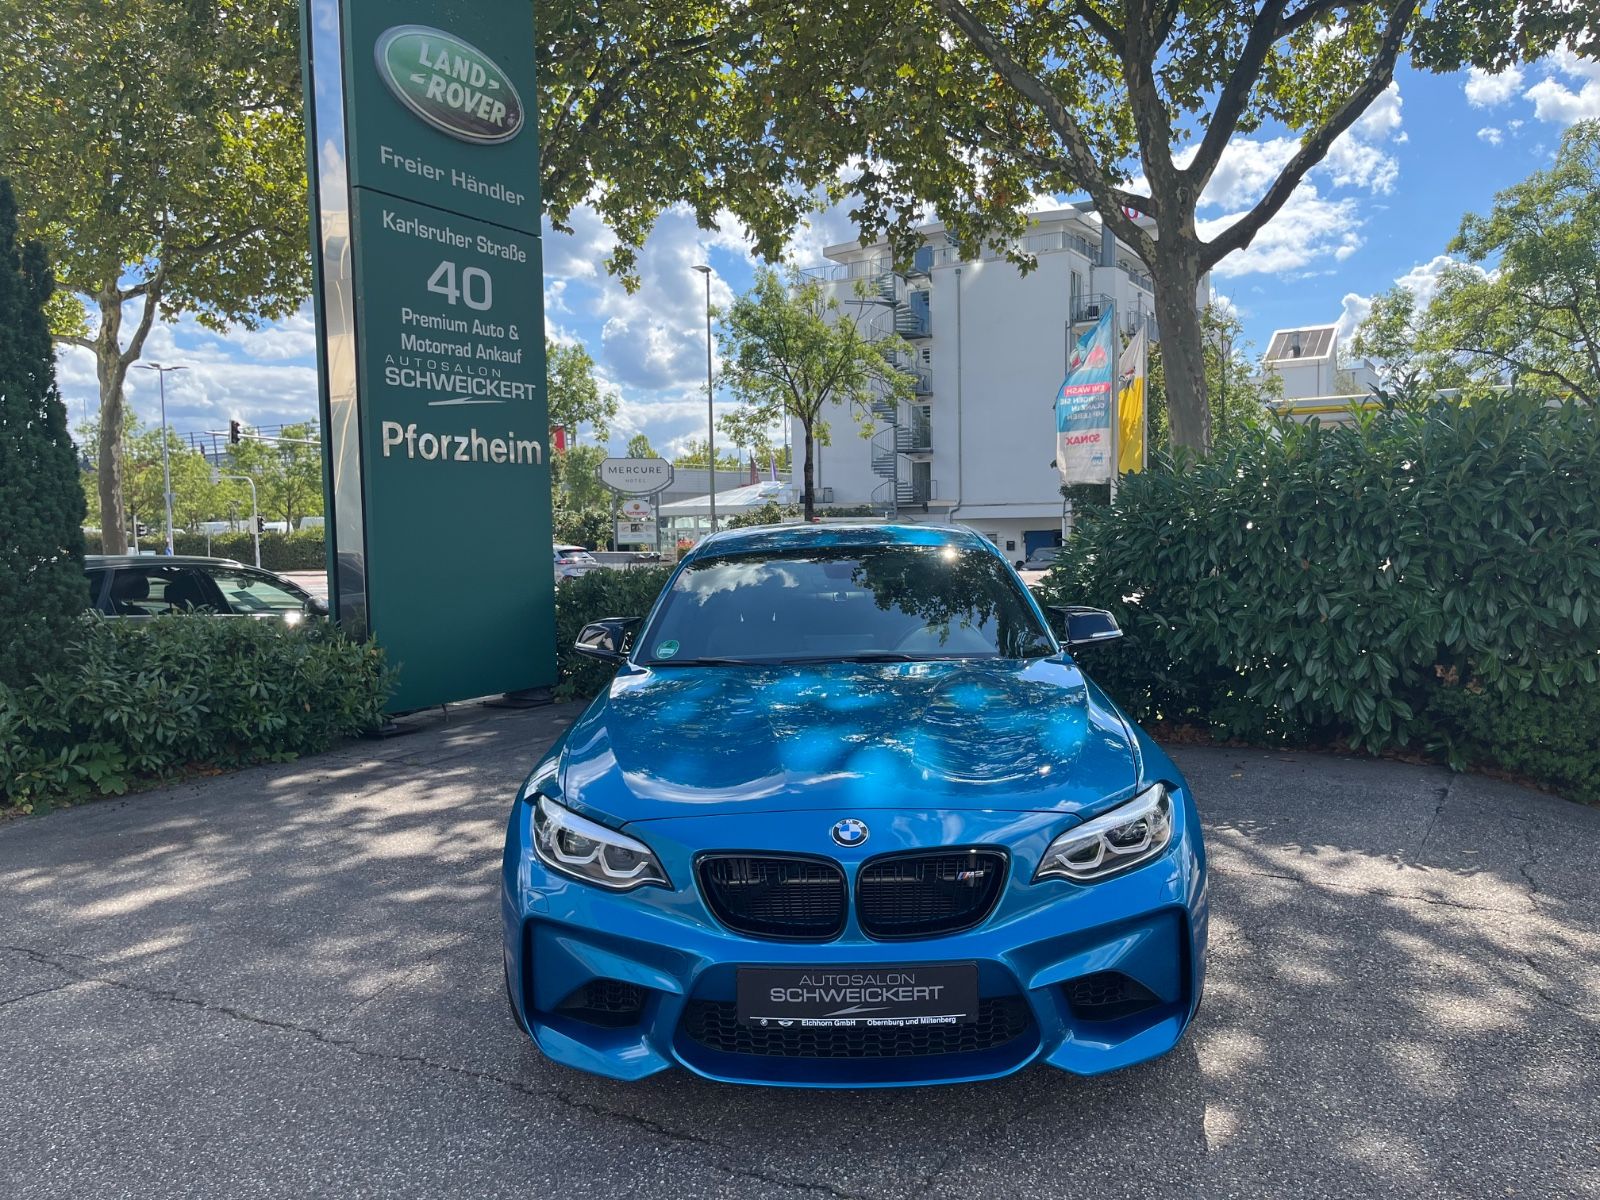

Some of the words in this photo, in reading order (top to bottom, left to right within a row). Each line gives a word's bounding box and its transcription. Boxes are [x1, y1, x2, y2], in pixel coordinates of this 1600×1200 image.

[418, 42, 487, 88] LAND
[425, 73, 507, 127] ROVER
[380, 145, 445, 182] Freier
[451, 168, 525, 206] Händler
[382, 210, 473, 249] Karlsruher
[476, 235, 527, 263] Straße
[427, 260, 493, 311] 40
[401, 307, 468, 334] Premium
[472, 319, 505, 339] Auto
[508, 324, 520, 341] &
[385, 354, 501, 378] AUTOSALON
[401, 333, 472, 358] Motorrad
[475, 344, 522, 365] Ankauf
[385, 366, 536, 401] SCHWEICKERT
[381, 421, 542, 465] Pforzheim
[608, 466, 662, 475] MERCURE
[769, 985, 945, 1003] SCHWEICKERT
[799, 973, 916, 987] AUTOSALON
[834, 1018, 857, 1027] GmbH
[866, 1018, 905, 1027] Obernburg
[906, 1017, 919, 1026] und
